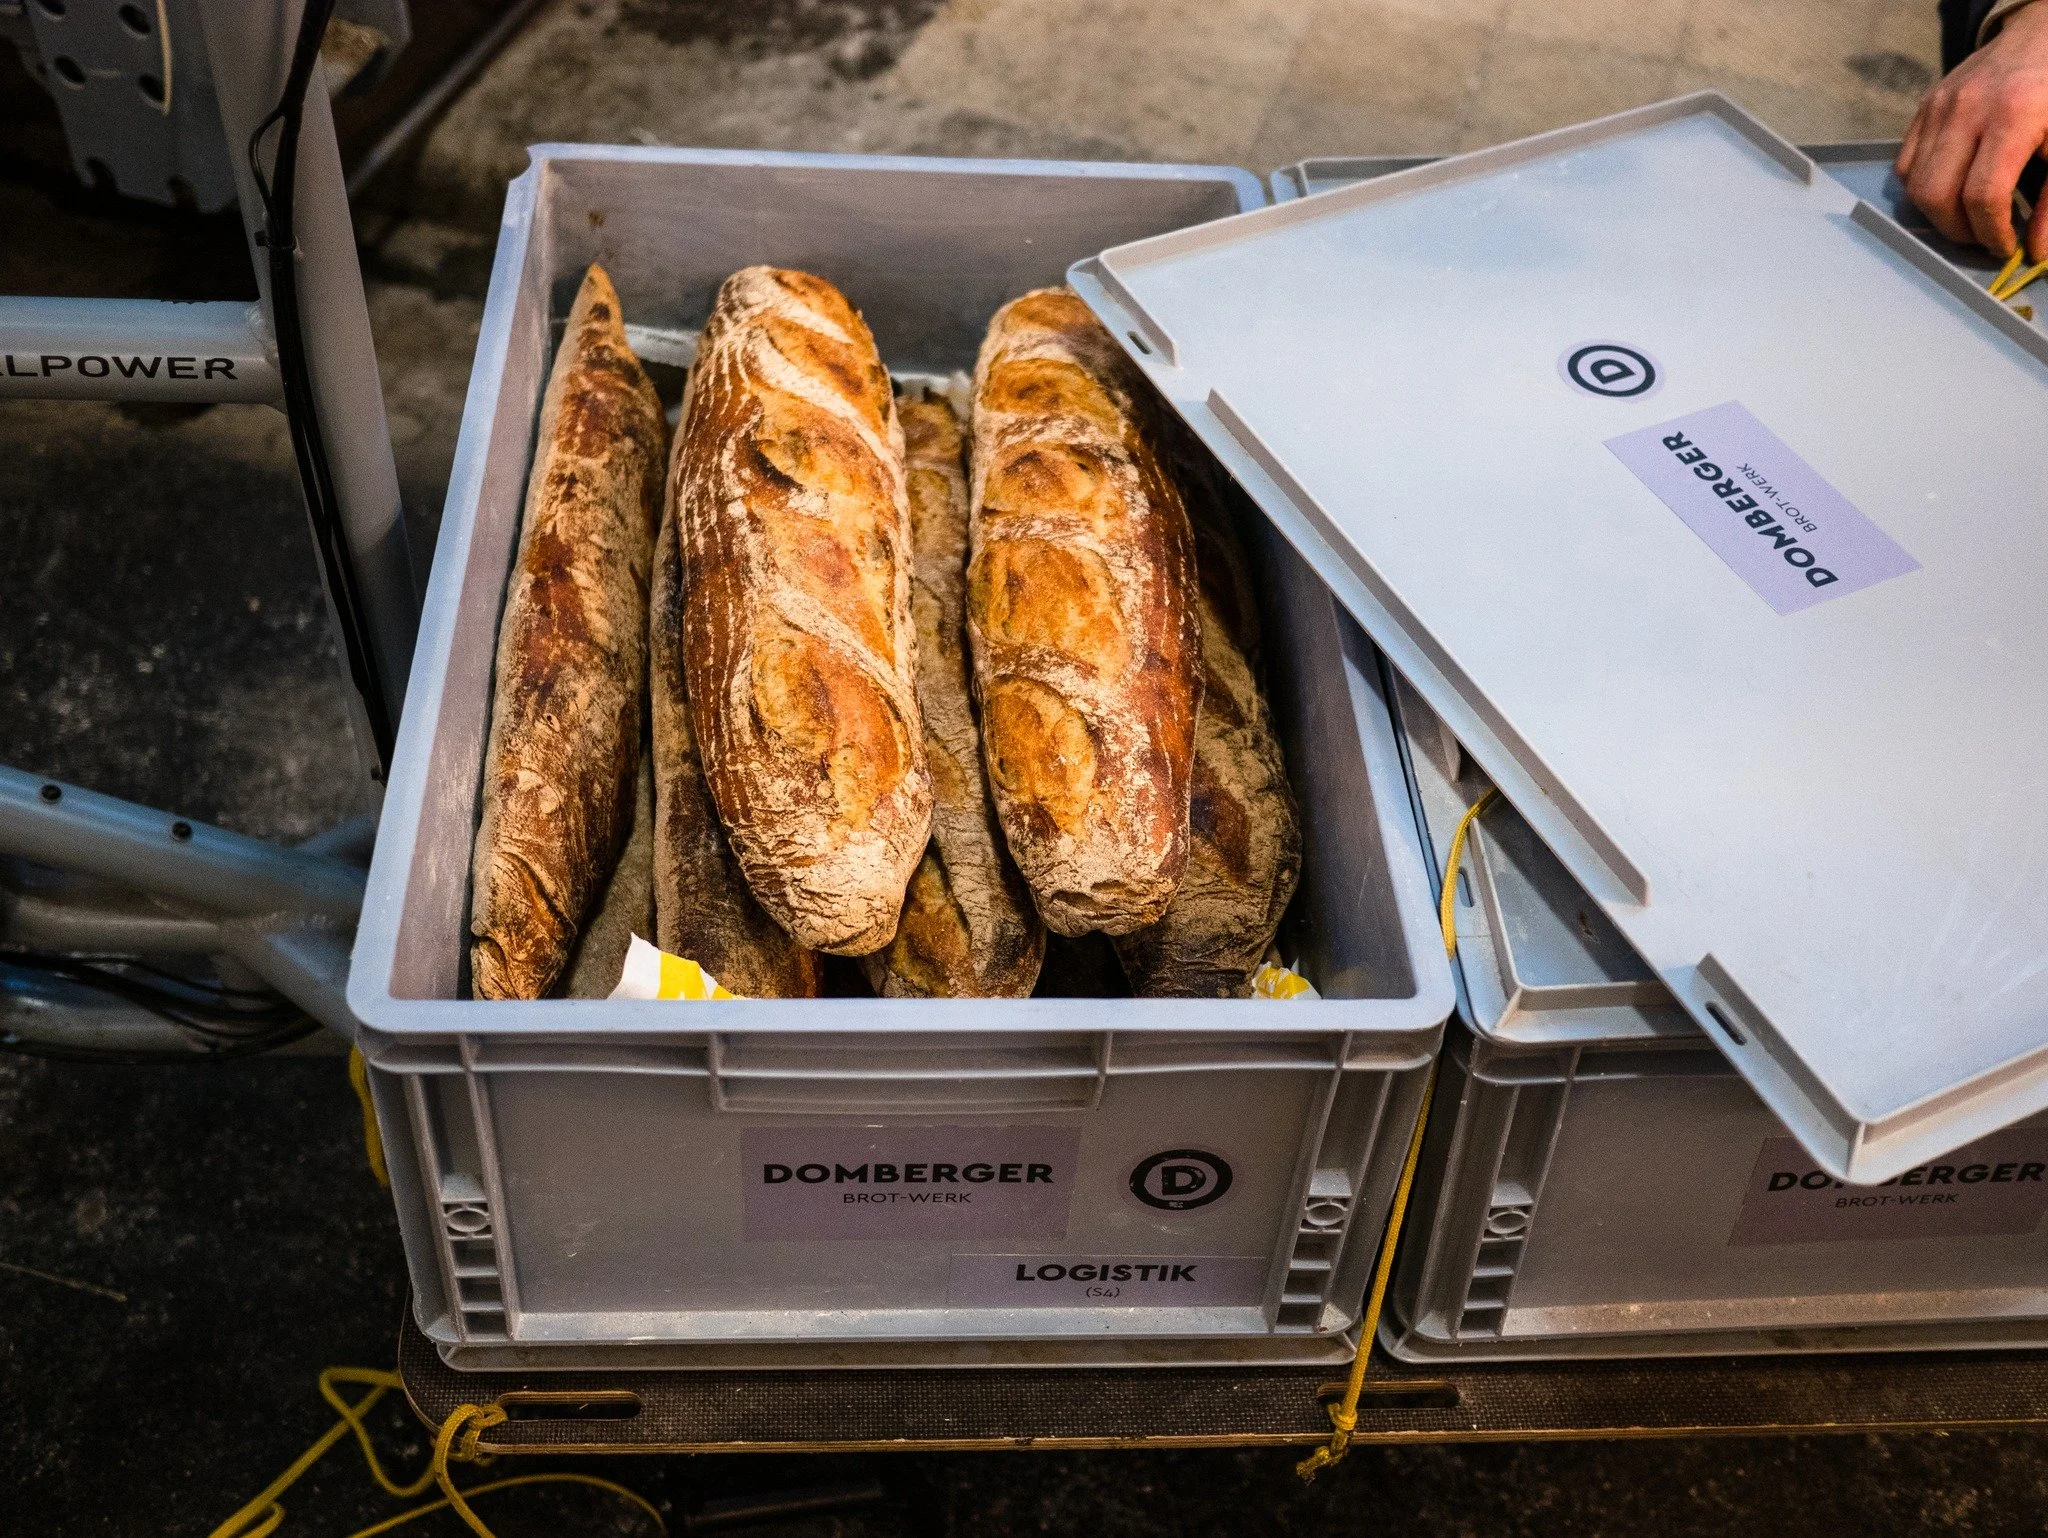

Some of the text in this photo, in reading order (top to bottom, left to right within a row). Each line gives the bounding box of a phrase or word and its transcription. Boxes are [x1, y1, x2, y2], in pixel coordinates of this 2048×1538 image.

[0, 354, 239, 380] LPOWER
[1590, 359, 1636, 384] D
[1662, 430, 1840, 588] DOMBERGER
[1736, 462, 1818, 533] BROT-WERK
[764, 1163, 1055, 1184] DOMBERGER
[1162, 1165, 1206, 1195] D
[1767, 1162, 2046, 1191] DOERGER
[843, 1192, 972, 1204] BROT-WERK
[1835, 1193, 1960, 1208] BROT-WERK
[1015, 1264, 1198, 1282] LOGISTIK
[1086, 1286, 1121, 1298] (S4)
